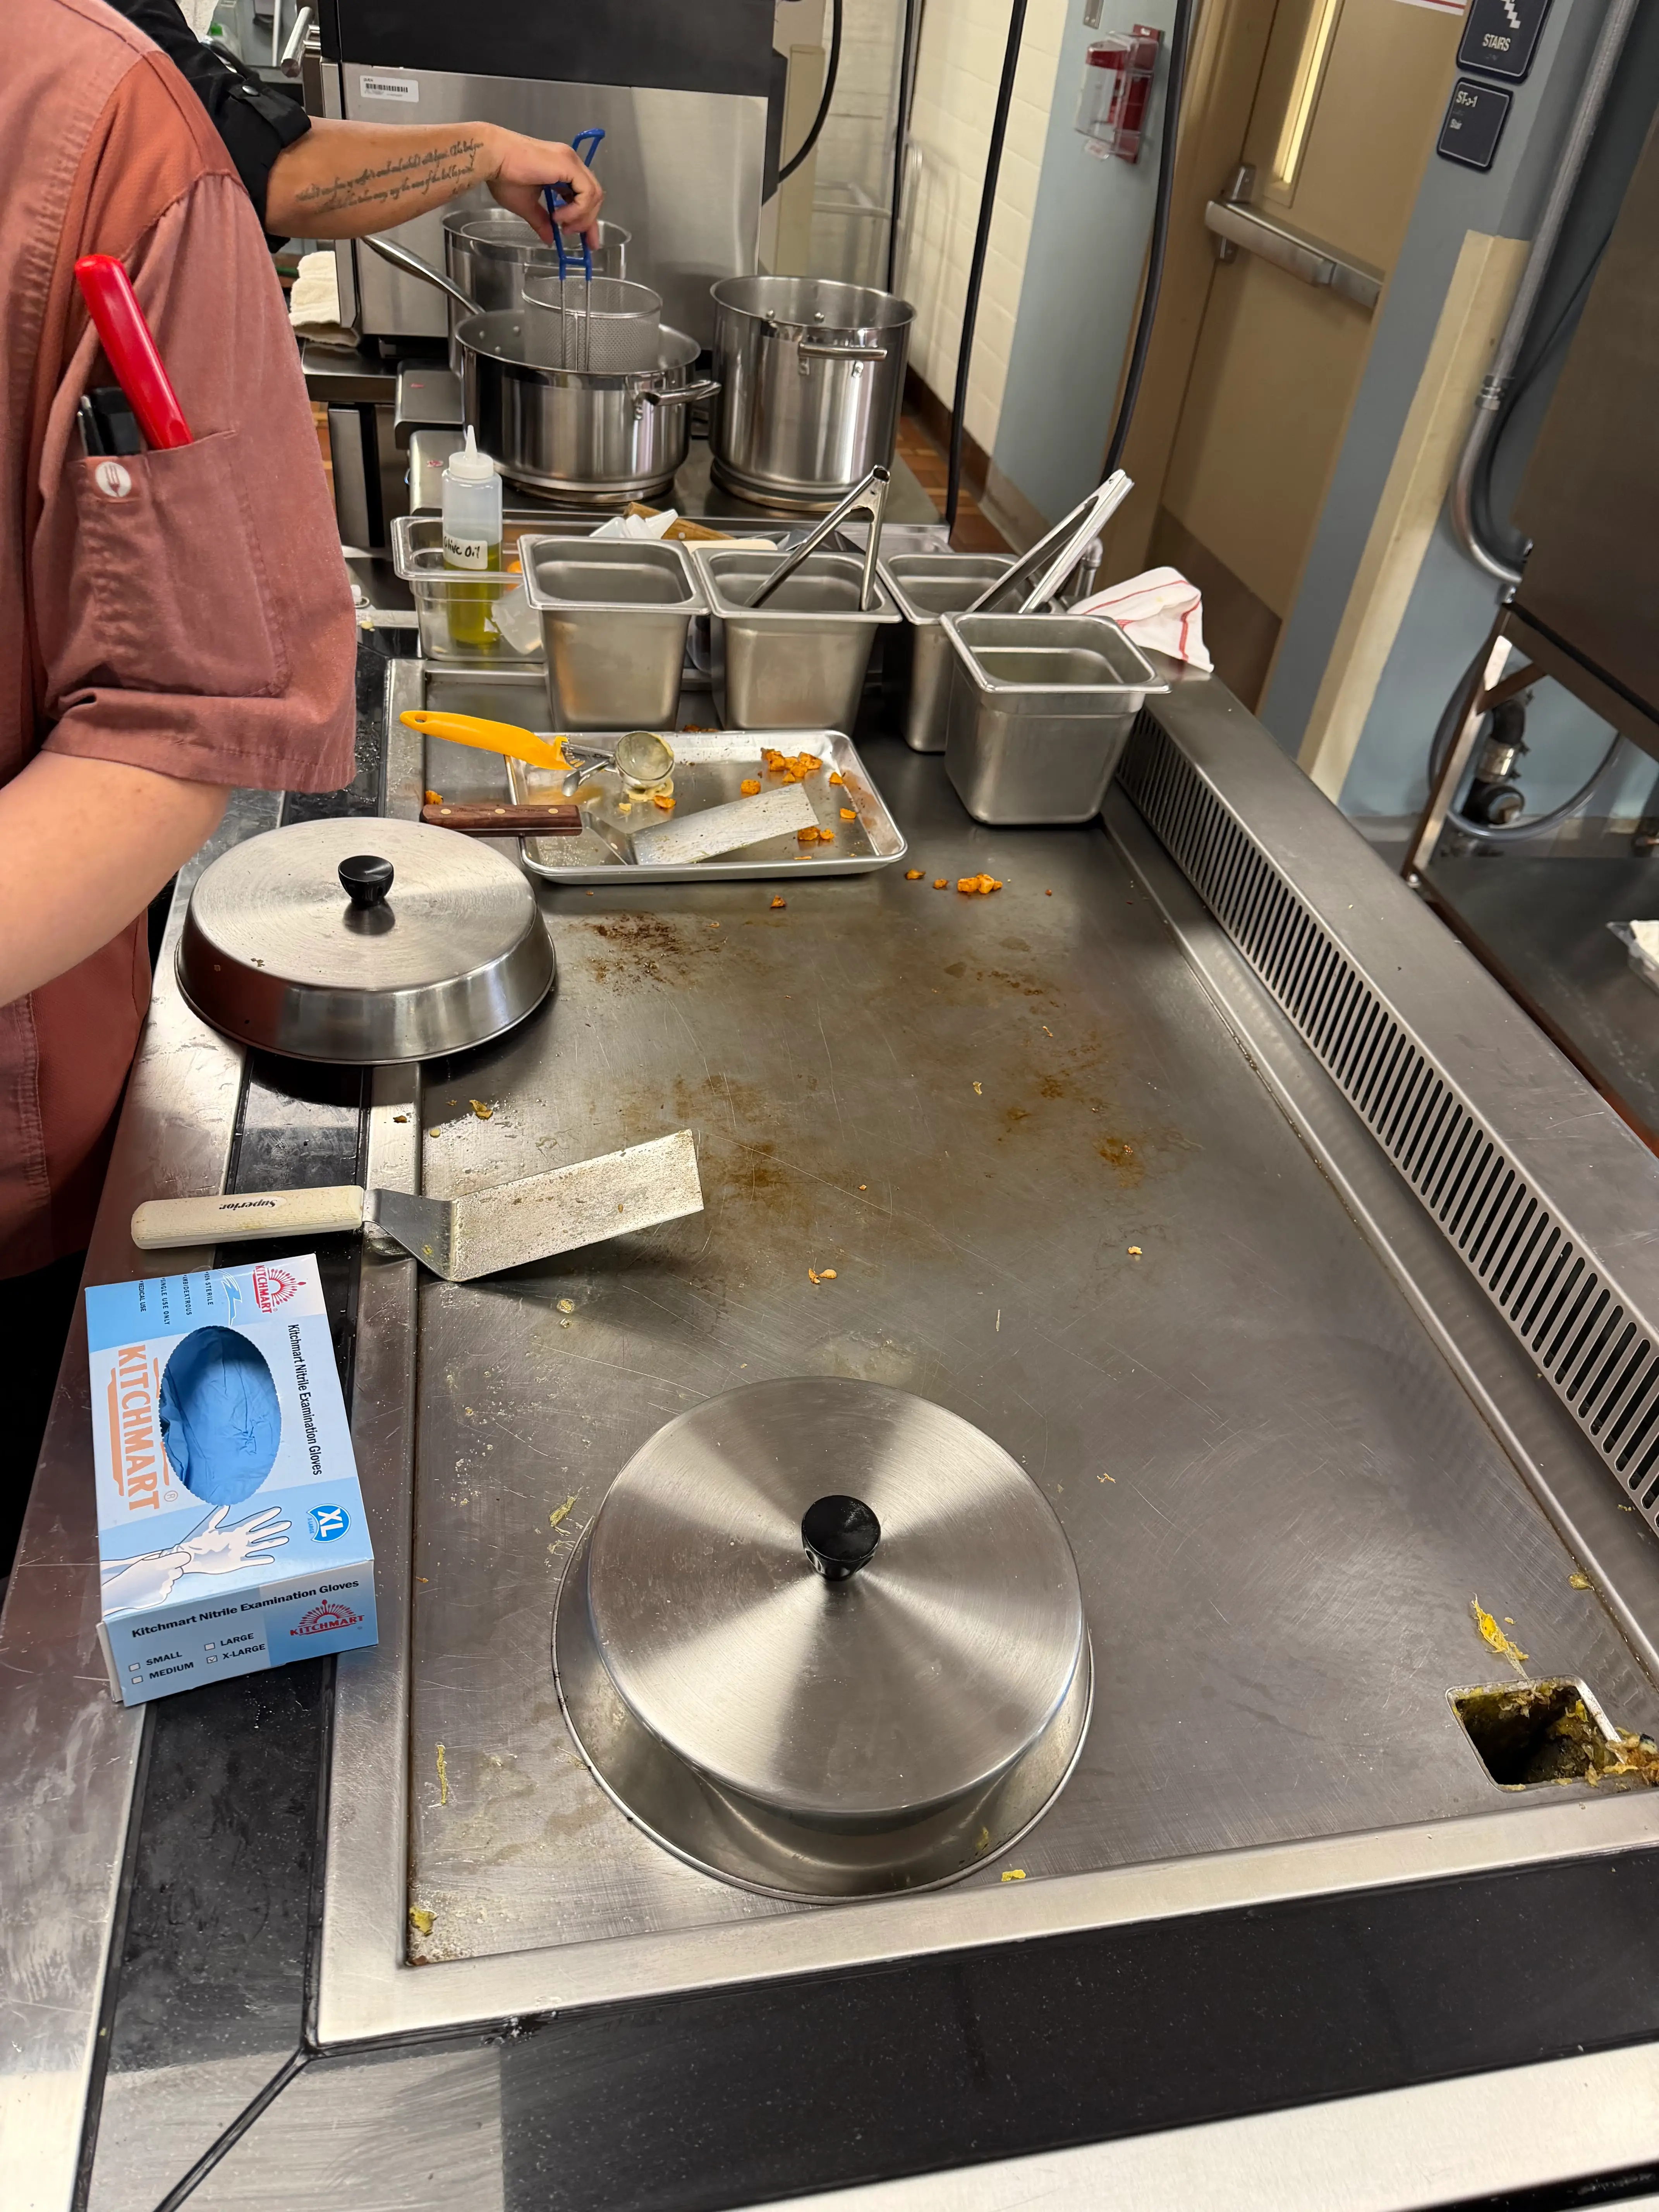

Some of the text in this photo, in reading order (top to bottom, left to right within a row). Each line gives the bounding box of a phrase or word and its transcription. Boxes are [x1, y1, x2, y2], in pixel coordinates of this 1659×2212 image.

[1482, 33, 1511, 51] STAIRS
[444, 536, 480, 559] Olive Oil
[255, 1265, 272, 1313] KITCHMART
[288, 1324, 322, 1475] Kitchmart Nitrile Examination Gloves
[118, 1345, 160, 1510] KITCHMART
[318, 1508, 343, 1537] XL
[132, 1581, 359, 1638] Kitchmart Nitrile Examination Gloves
[290, 1615, 365, 1636] KITCHMART
[220, 1633, 254, 1646] LARGE
[146, 1652, 182, 1666] SMALL
[223, 1644, 266, 1660] X-LARGE
[149, 1662, 194, 1679] MEDIUM
